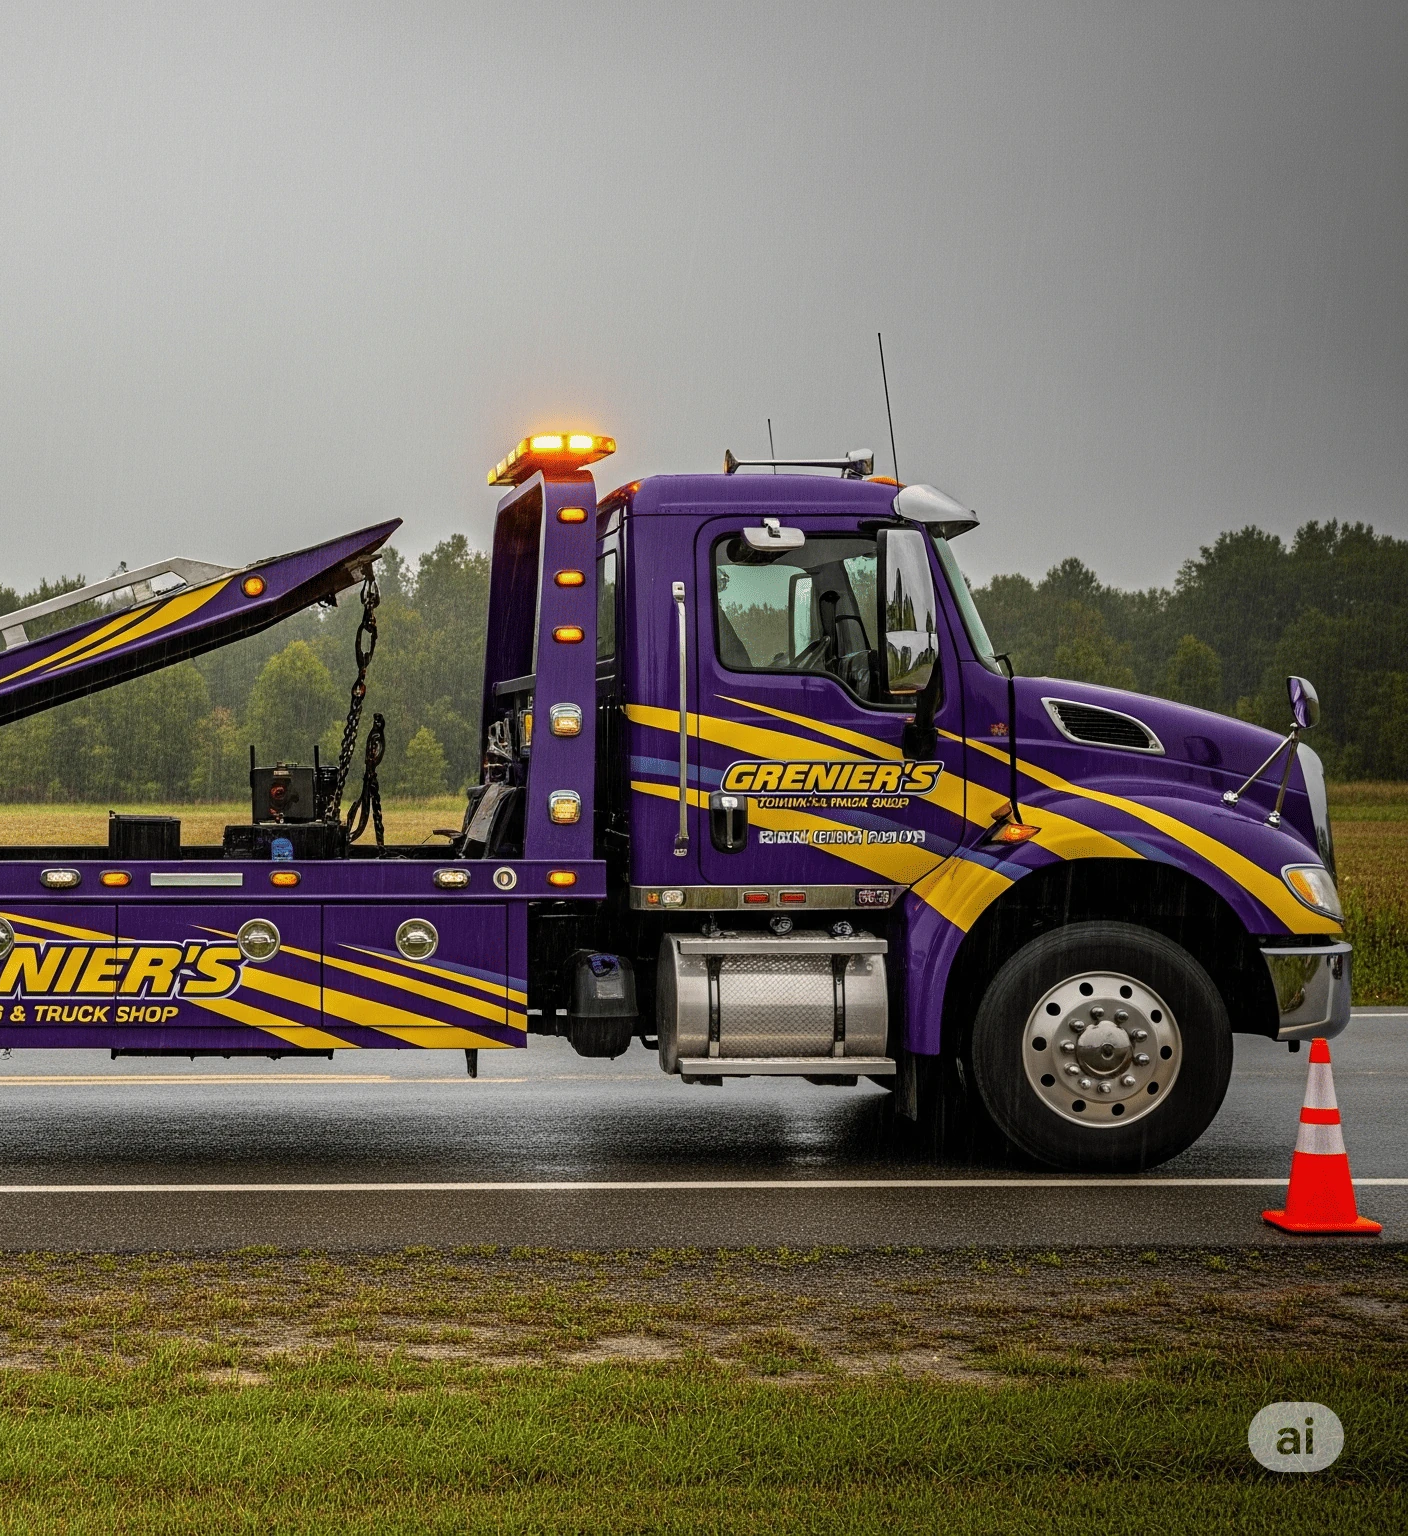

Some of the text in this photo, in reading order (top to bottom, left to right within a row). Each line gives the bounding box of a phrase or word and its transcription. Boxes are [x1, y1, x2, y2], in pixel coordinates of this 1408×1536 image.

[723, 761, 942, 793] GRENIER'S
[9, 1004, 26, 1022] &
[34, 1004, 110, 1022] TRUCK
[115, 1005, 179, 1023] SHOP
